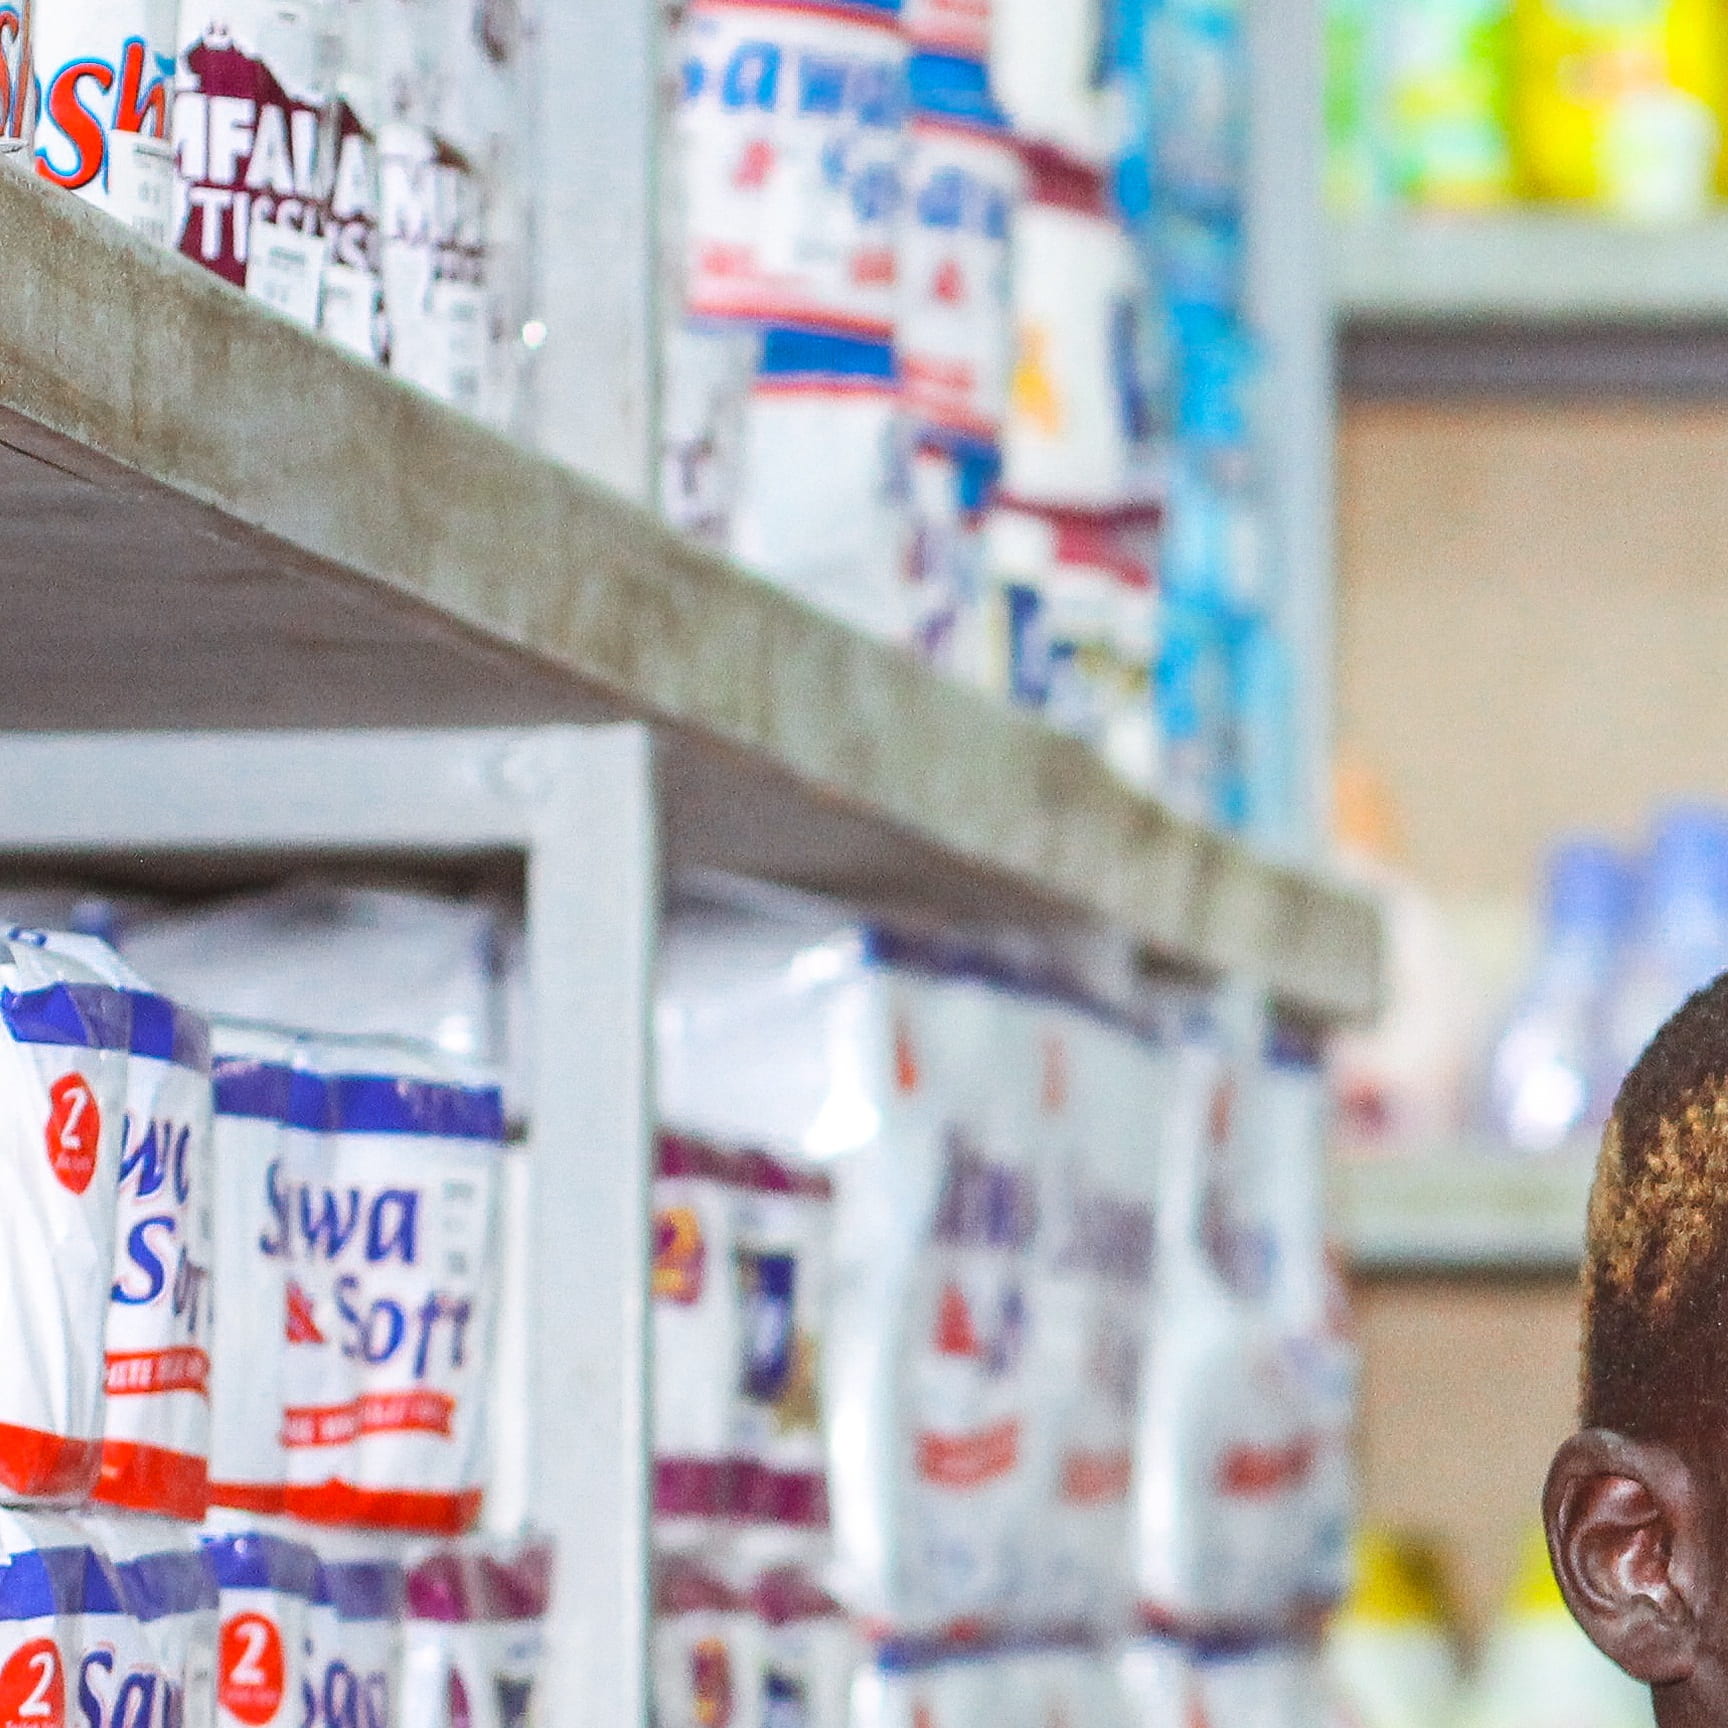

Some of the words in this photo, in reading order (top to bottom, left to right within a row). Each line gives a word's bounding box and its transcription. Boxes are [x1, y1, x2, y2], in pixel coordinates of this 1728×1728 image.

[61, 1085, 89, 1151] 2
[17, 1652, 55, 1718] 2
[231, 1621, 269, 1684] 2
